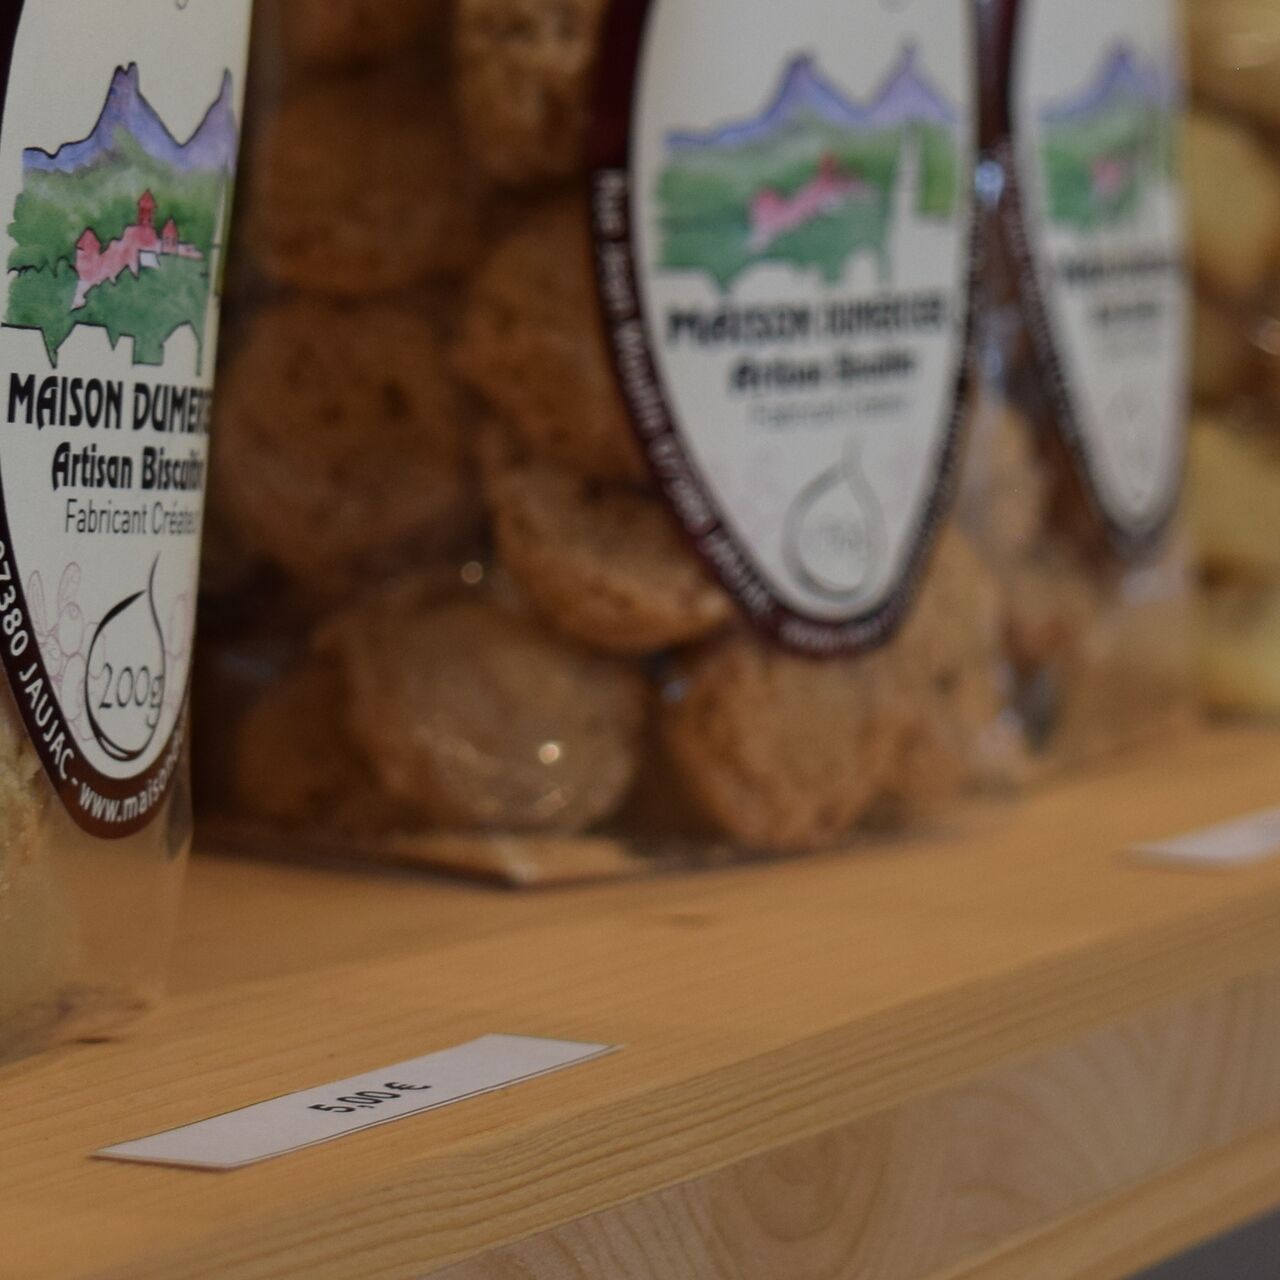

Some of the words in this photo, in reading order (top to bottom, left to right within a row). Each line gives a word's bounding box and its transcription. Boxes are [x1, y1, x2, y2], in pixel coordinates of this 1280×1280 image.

[6, 372, 124, 431] MAISON
[51, 441, 133, 491] Artisan
[64, 497, 148, 534] Fabricant
[18, 662, 75, 780] JAUJAC
[98, 661, 164, 730] 200g
[307, 1090, 402, 1114] 5,00
[383, 1081, 433, 1091] €
